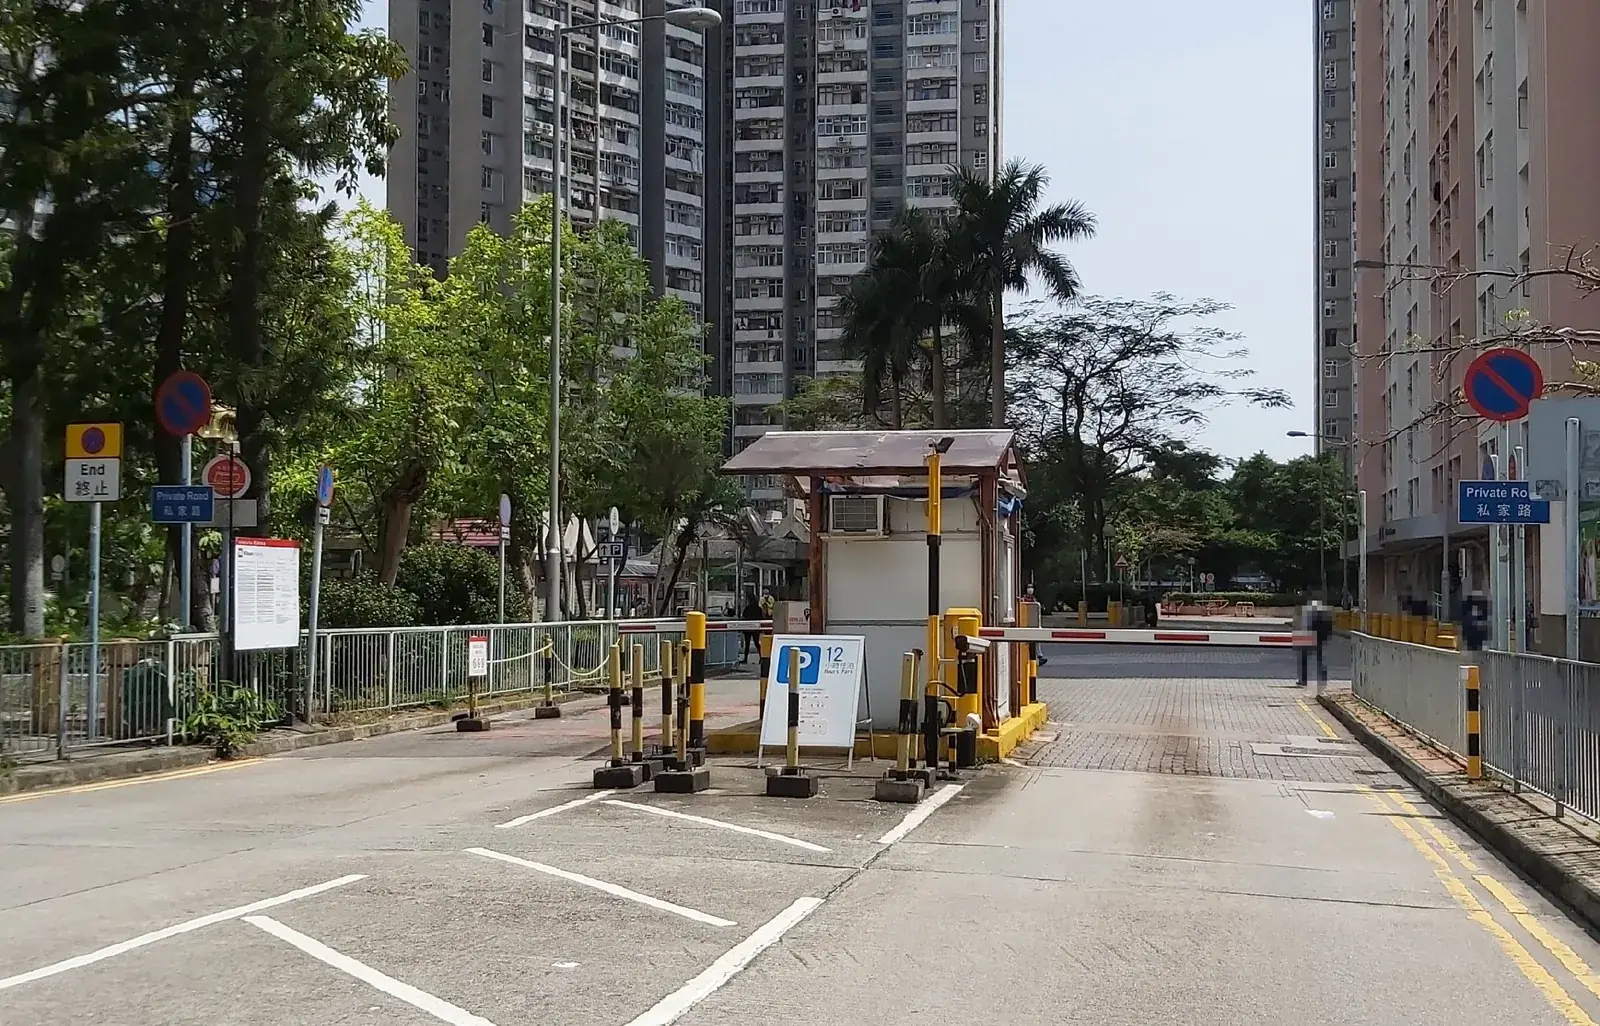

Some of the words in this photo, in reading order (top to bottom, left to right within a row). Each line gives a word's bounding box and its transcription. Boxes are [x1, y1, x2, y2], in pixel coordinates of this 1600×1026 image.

[81, 464, 105, 475] End
[75, 479, 109, 496] 終止
[1466, 487, 1507, 498] Private
[1511, 487, 1528, 498] Ro
[156, 491, 186, 500] Private
[187, 491, 209, 500] Road
[163, 505, 201, 517] 私家路
[1476, 503, 1532, 517] 私家路
[612, 545, 620, 555] P
[826, 646, 844, 662] 12
